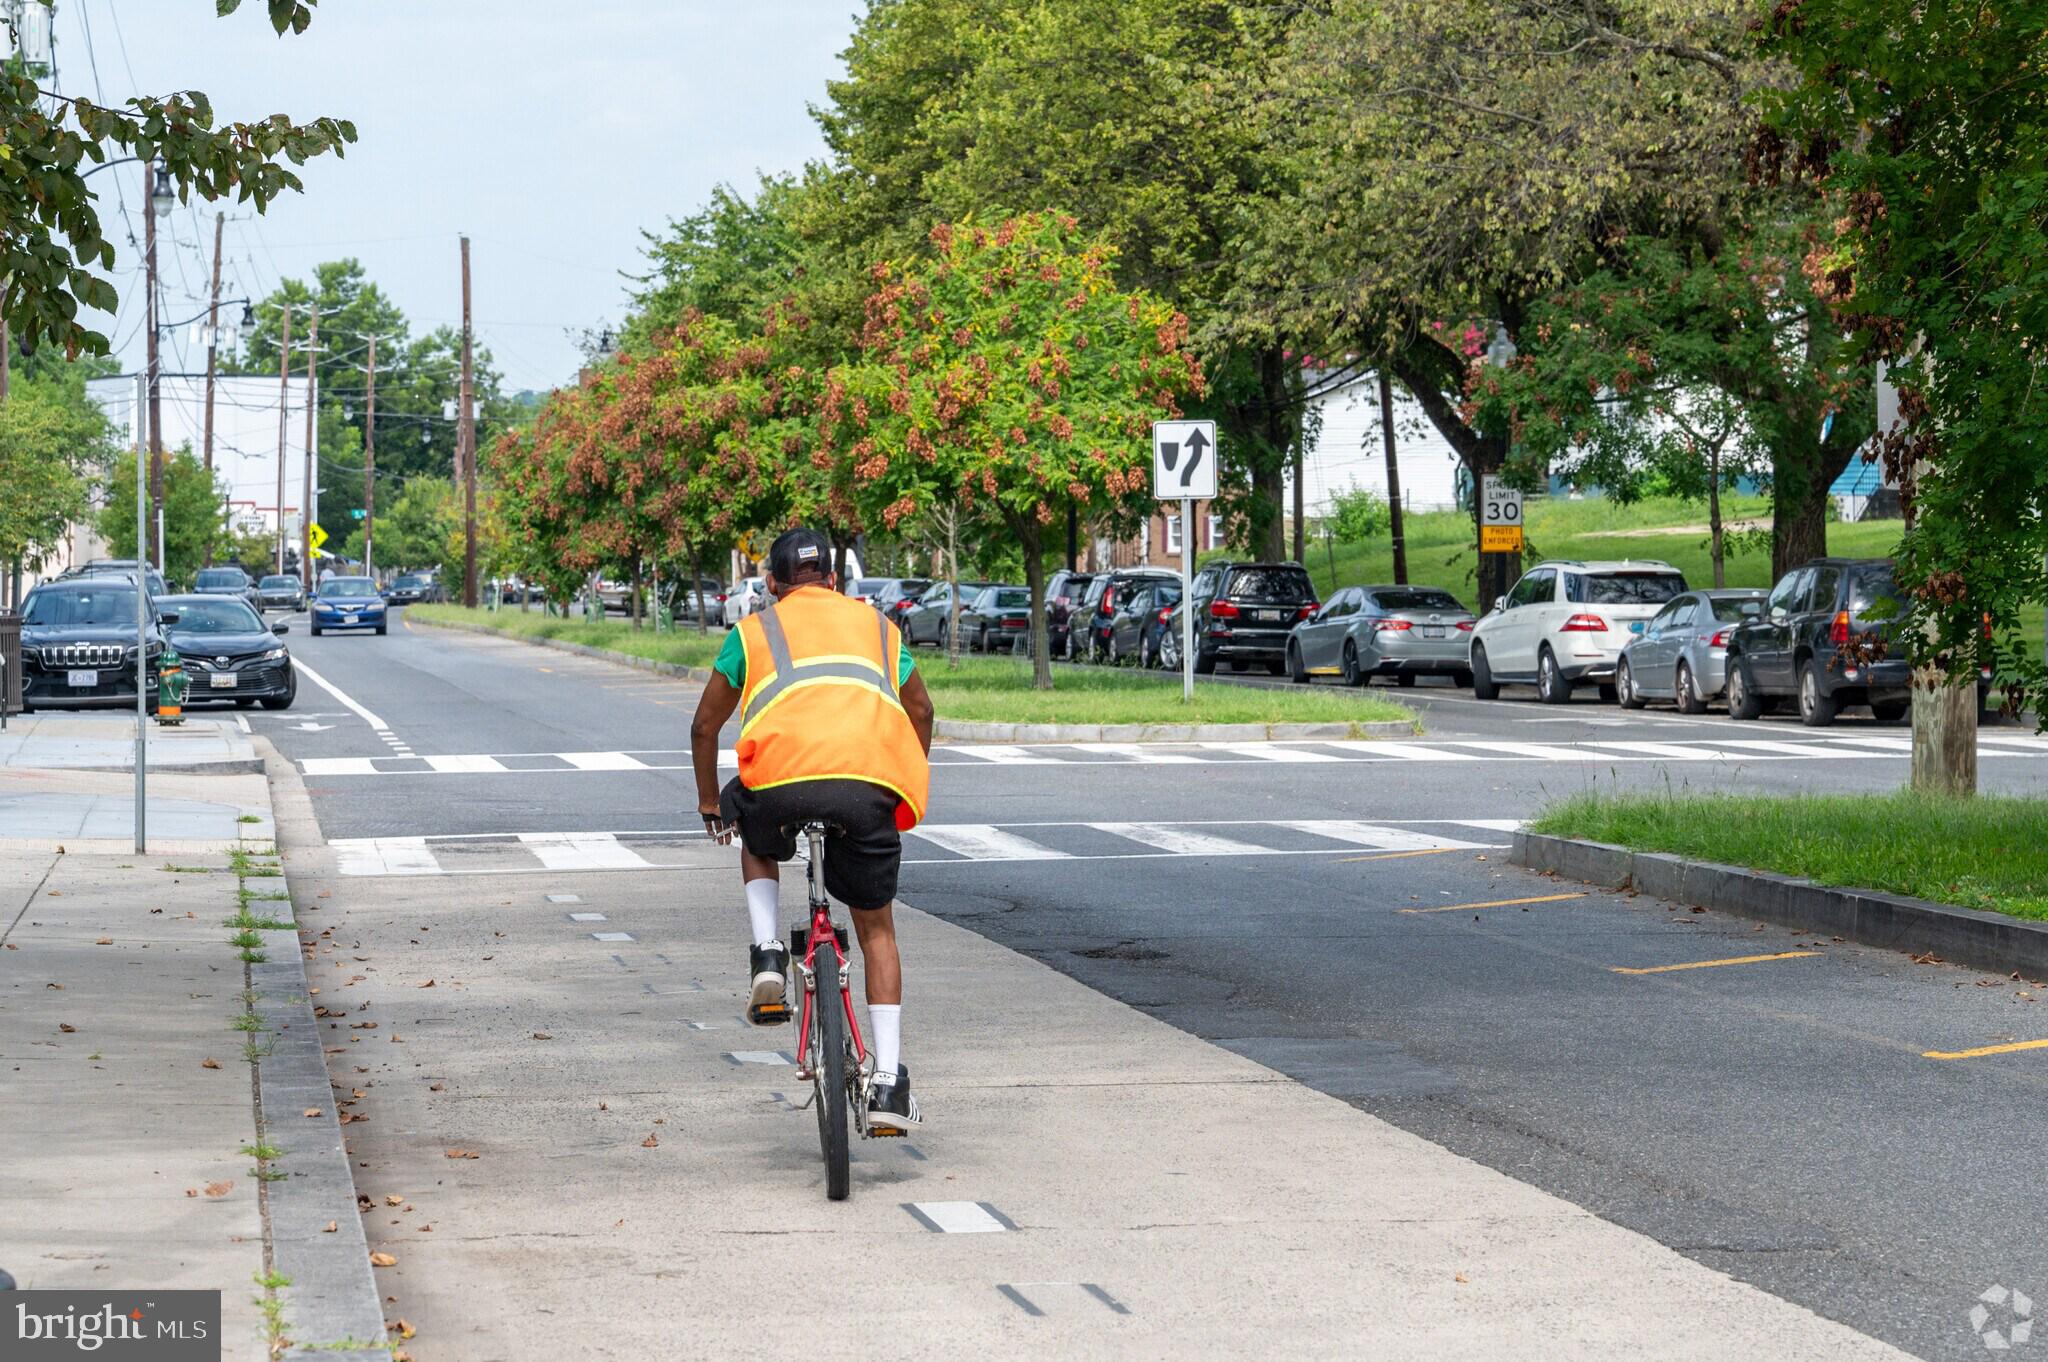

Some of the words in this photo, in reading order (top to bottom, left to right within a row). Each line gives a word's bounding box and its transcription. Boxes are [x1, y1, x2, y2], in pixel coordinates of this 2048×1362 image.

[1489, 492, 1515, 500] LIMIT
[1487, 502, 1518, 520] 30
[1490, 527, 1514, 535] PHOTO
[1484, 537, 1520, 545] ENFORCED
